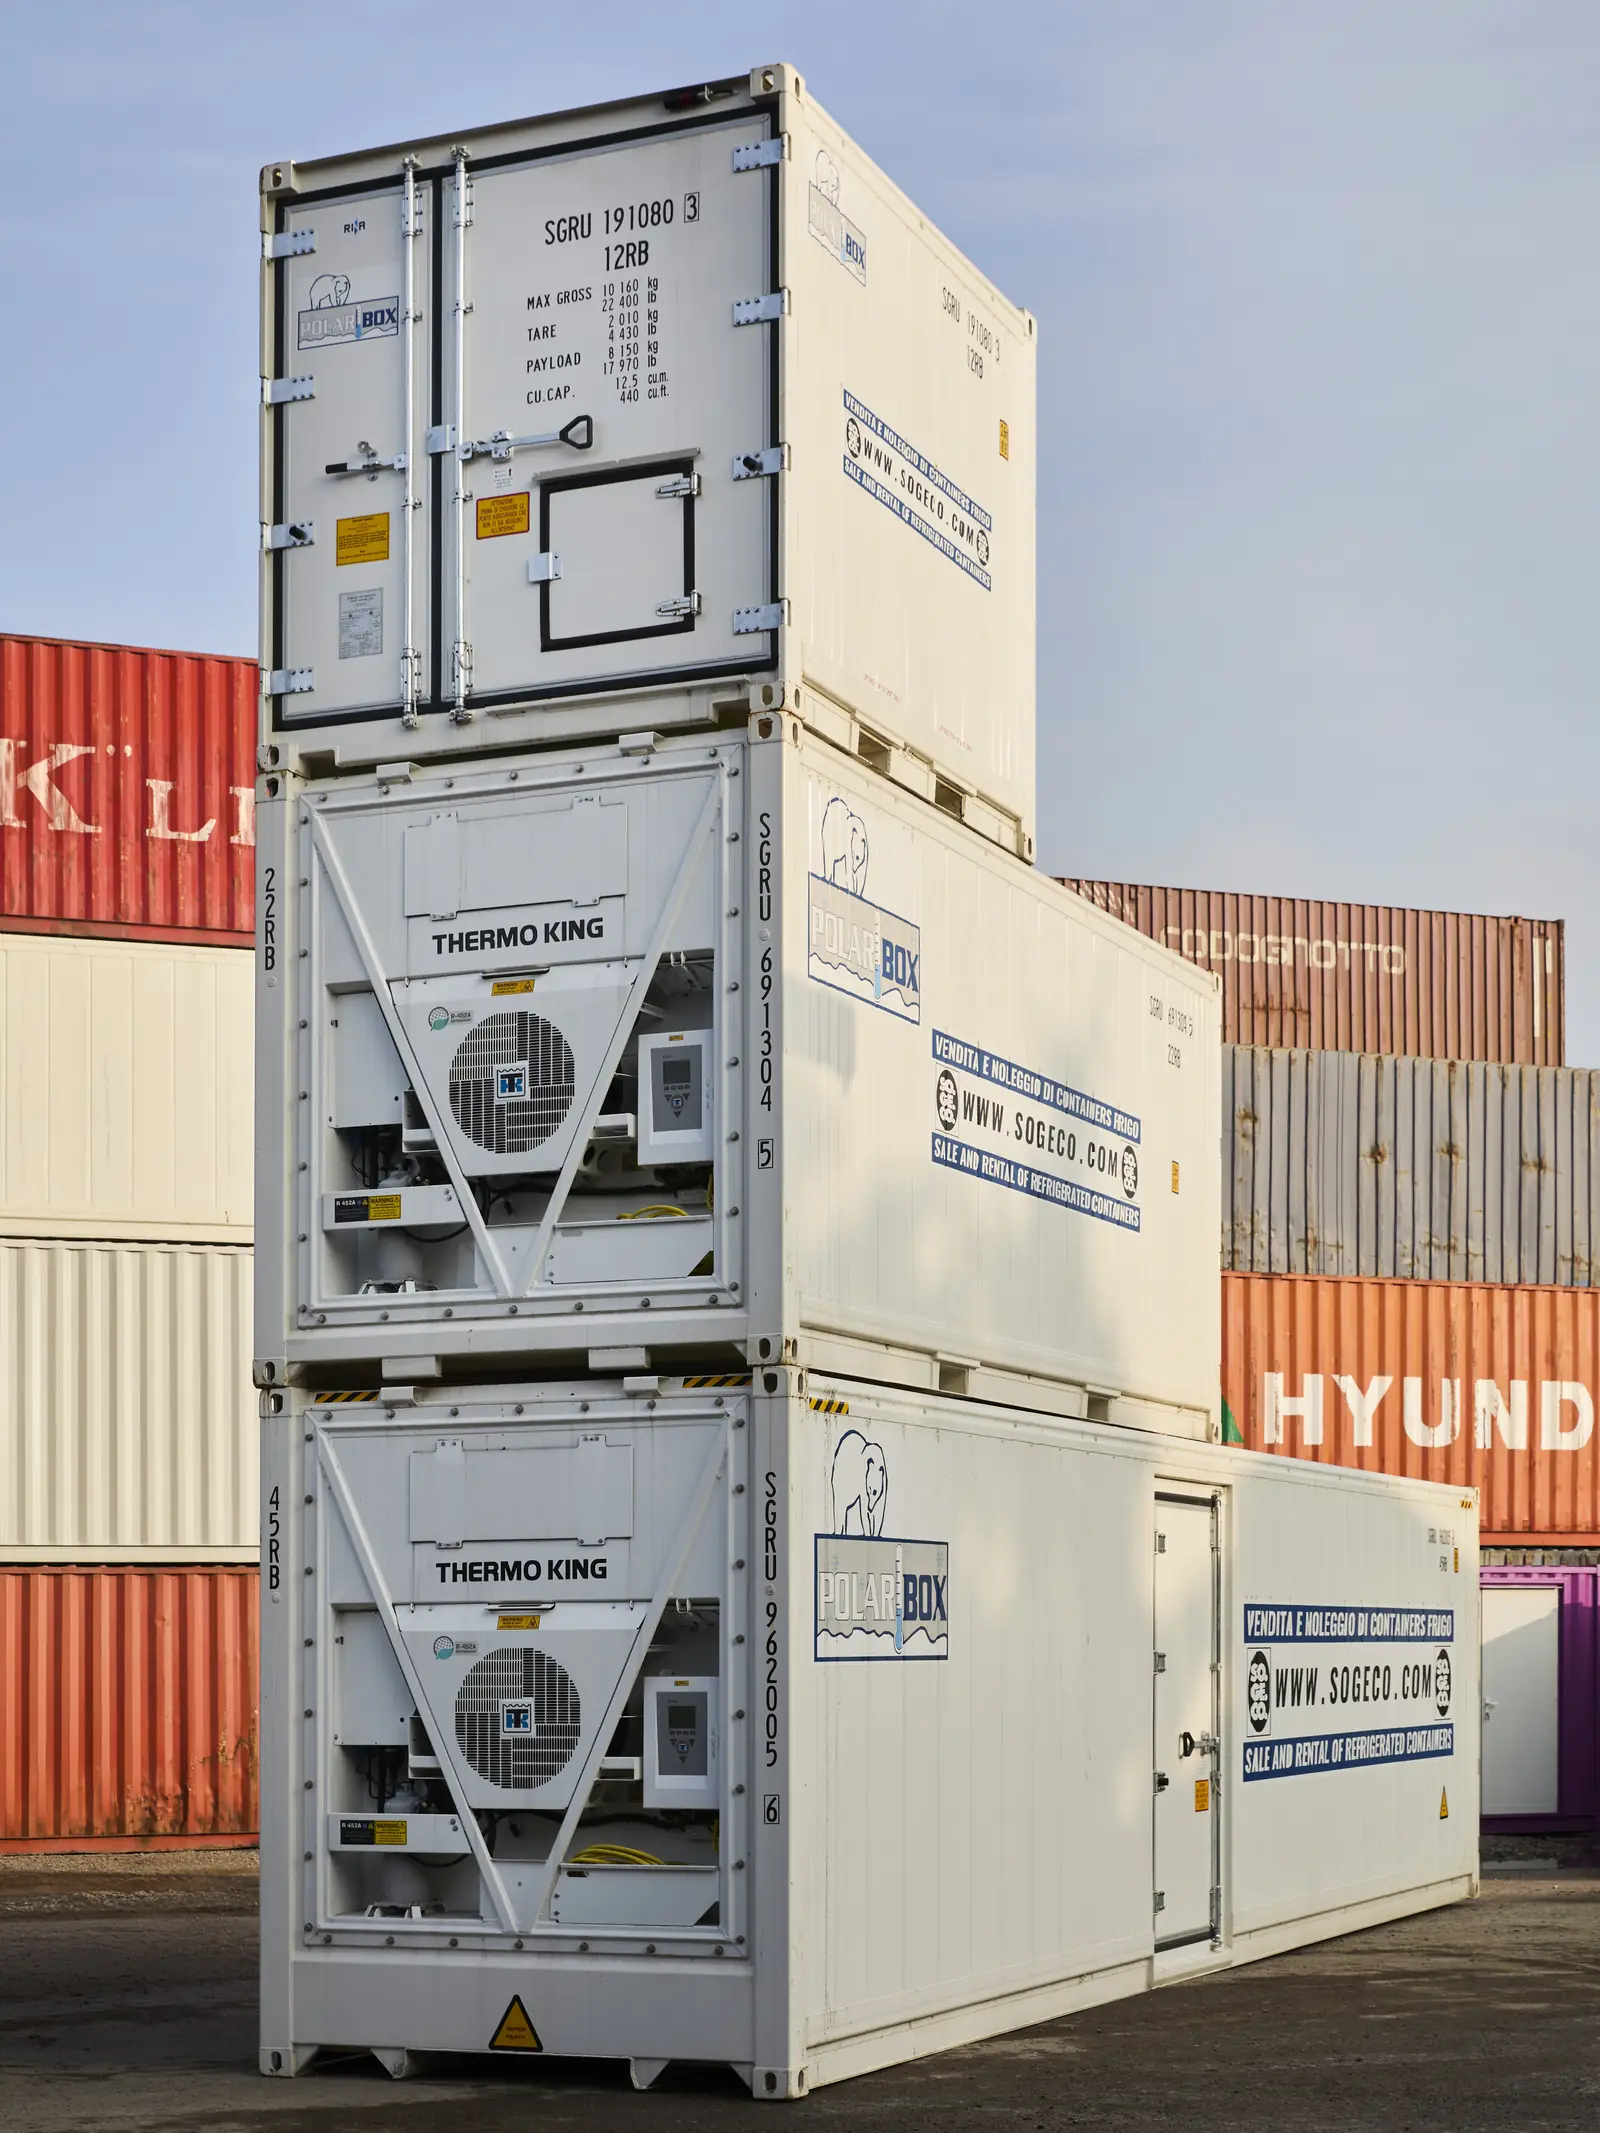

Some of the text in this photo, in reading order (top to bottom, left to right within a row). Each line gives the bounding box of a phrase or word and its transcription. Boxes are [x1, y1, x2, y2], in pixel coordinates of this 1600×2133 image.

[545, 194, 698, 245] SGRU 191080 3
[604, 240, 650, 271] 12RB
[845, 233, 866, 269] BOX
[527, 277, 659, 310] MAX GROSS 10 160 kg
[602, 291, 657, 312] 22 400 lb
[300, 306, 398, 338] POLAR BOX
[527, 309, 659, 341] TARE 2 010 kg
[608, 323, 657, 342] 4 430 lb
[942, 287, 960, 323] SGRU
[967, 311, 992, 354] 191080
[527, 340, 659, 373] PAYLOAD 8 150 kg
[603, 355, 657, 375] 17 970 lb
[967, 345, 983, 380] 12RB
[527, 371, 669, 404] CU.CAP. 12.5 cu.m.
[620, 385, 670, 404] 440 cu.ft.
[845, 393, 991, 528] VENDITA E NOLEGGIO DI CONTAINERS FRIGO
[844, 458, 861, 482] SALE
[862, 473, 876, 494] AND
[876, 484, 901, 514] RENTAL
[911, 511, 954, 558] REFRIGERATED
[955, 547, 991, 588] CONTAINERS
[759, 812, 771, 921] SGRU
[264, 867, 276, 971] 22RB
[432, 917, 604, 955] THERMO KING
[812, 904, 919, 994] POLAR BOX
[760, 946, 772, 1112] 691304
[935, 1034, 1139, 1139] VENDITA E NOLEGGIO DI CONTAINERS FRIGO
[963, 1090, 1118, 1178] WWW.SOGECO.COM
[934, 1138, 1139, 1227] SALE AND RENTAL OF REFRIGERATED CONTAINERS
[1263, 1372, 1595, 1452] HYUND
[269, 1486, 280, 1590] 45RB
[764, 1471, 777, 1581] SGRU
[435, 1558, 607, 1583] THERMO KING
[818, 1571, 947, 1622] POLAR BOX
[1247, 1610, 1452, 1637] VENDITA E NOLEGGIO DI CONTAINERS FRIGO
[765, 1602, 777, 1768] 962005
[1275, 1664, 1432, 1708] WWW.SOGECO.COM
[1245, 1727, 1453, 1774] SALE AND RENTAL OF REFRIGERATED CONTAINERS
